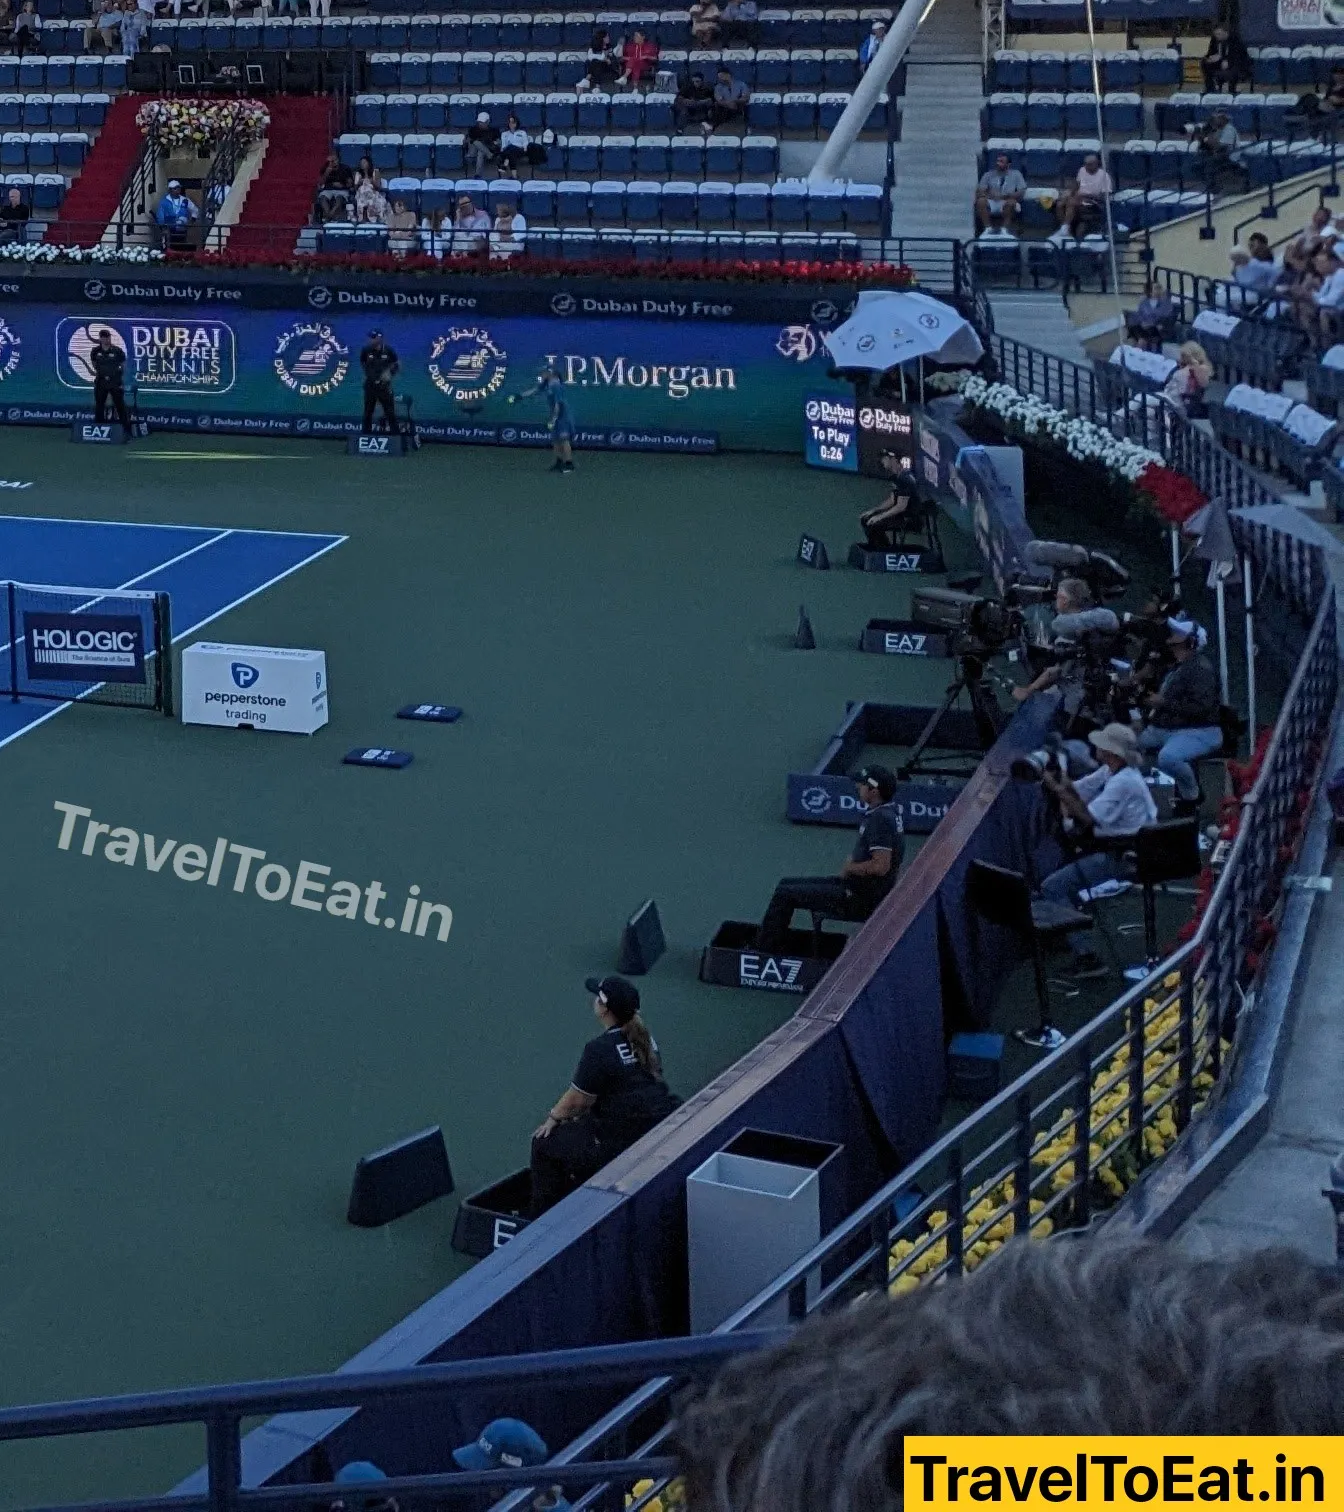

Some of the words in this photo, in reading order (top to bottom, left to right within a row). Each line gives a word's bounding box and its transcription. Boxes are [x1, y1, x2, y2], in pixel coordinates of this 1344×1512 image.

[112, 284, 159, 297] Dubai
[164, 285, 202, 300] Duty
[207, 286, 242, 300] Free
[339, 291, 389, 304] Dubai
[394, 292, 435, 308] Duty
[439, 294, 477, 308] Free
[582, 298, 637, 313] Dubai
[643, 300, 687, 317] Duty
[692, 301, 733, 316] Free
[132, 326, 220, 347] DUBAI
[134, 346, 176, 359] DUTY
[181, 347, 220, 360] FREE
[133, 359, 220, 374] TENNIS
[135, 372, 220, 385] CHAMPIONSHIPS
[274, 359, 297, 389] DUBAI
[300, 382, 330, 395] DUTY
[428, 364, 452, 396] DUBAI
[455, 386, 487, 400] DUTY
[820, 401, 855, 418] Dubai
[875, 408, 911, 424] Dubai
[269, 420, 290, 429] Free
[822, 414, 838, 424] Duty
[838, 416, 855, 426] Free
[876, 421, 893, 433] Duty
[894, 424, 911, 435] Free
[82, 425, 111, 438] EA7
[415, 426, 445, 435] Dubai
[447, 427, 471, 438] Duty
[474, 429, 496, 438] Free
[581, 433, 604, 442] Free
[812, 426, 825, 440] To
[827, 427, 850, 446] Play
[358, 437, 389, 450] EA7
[629, 435, 661, 444] Dubai
[664, 436, 689, 446] Duty
[692, 437, 716, 445] Free
[820, 445, 843, 461] 0:26
[886, 554, 921, 569] EA7
[33, 628, 135, 651] HOLOGIC
[885, 633, 927, 651] EA7
[205, 691, 287, 707] pepperstone
[225, 708, 266, 724] trading
[740, 954, 803, 983] EA7
